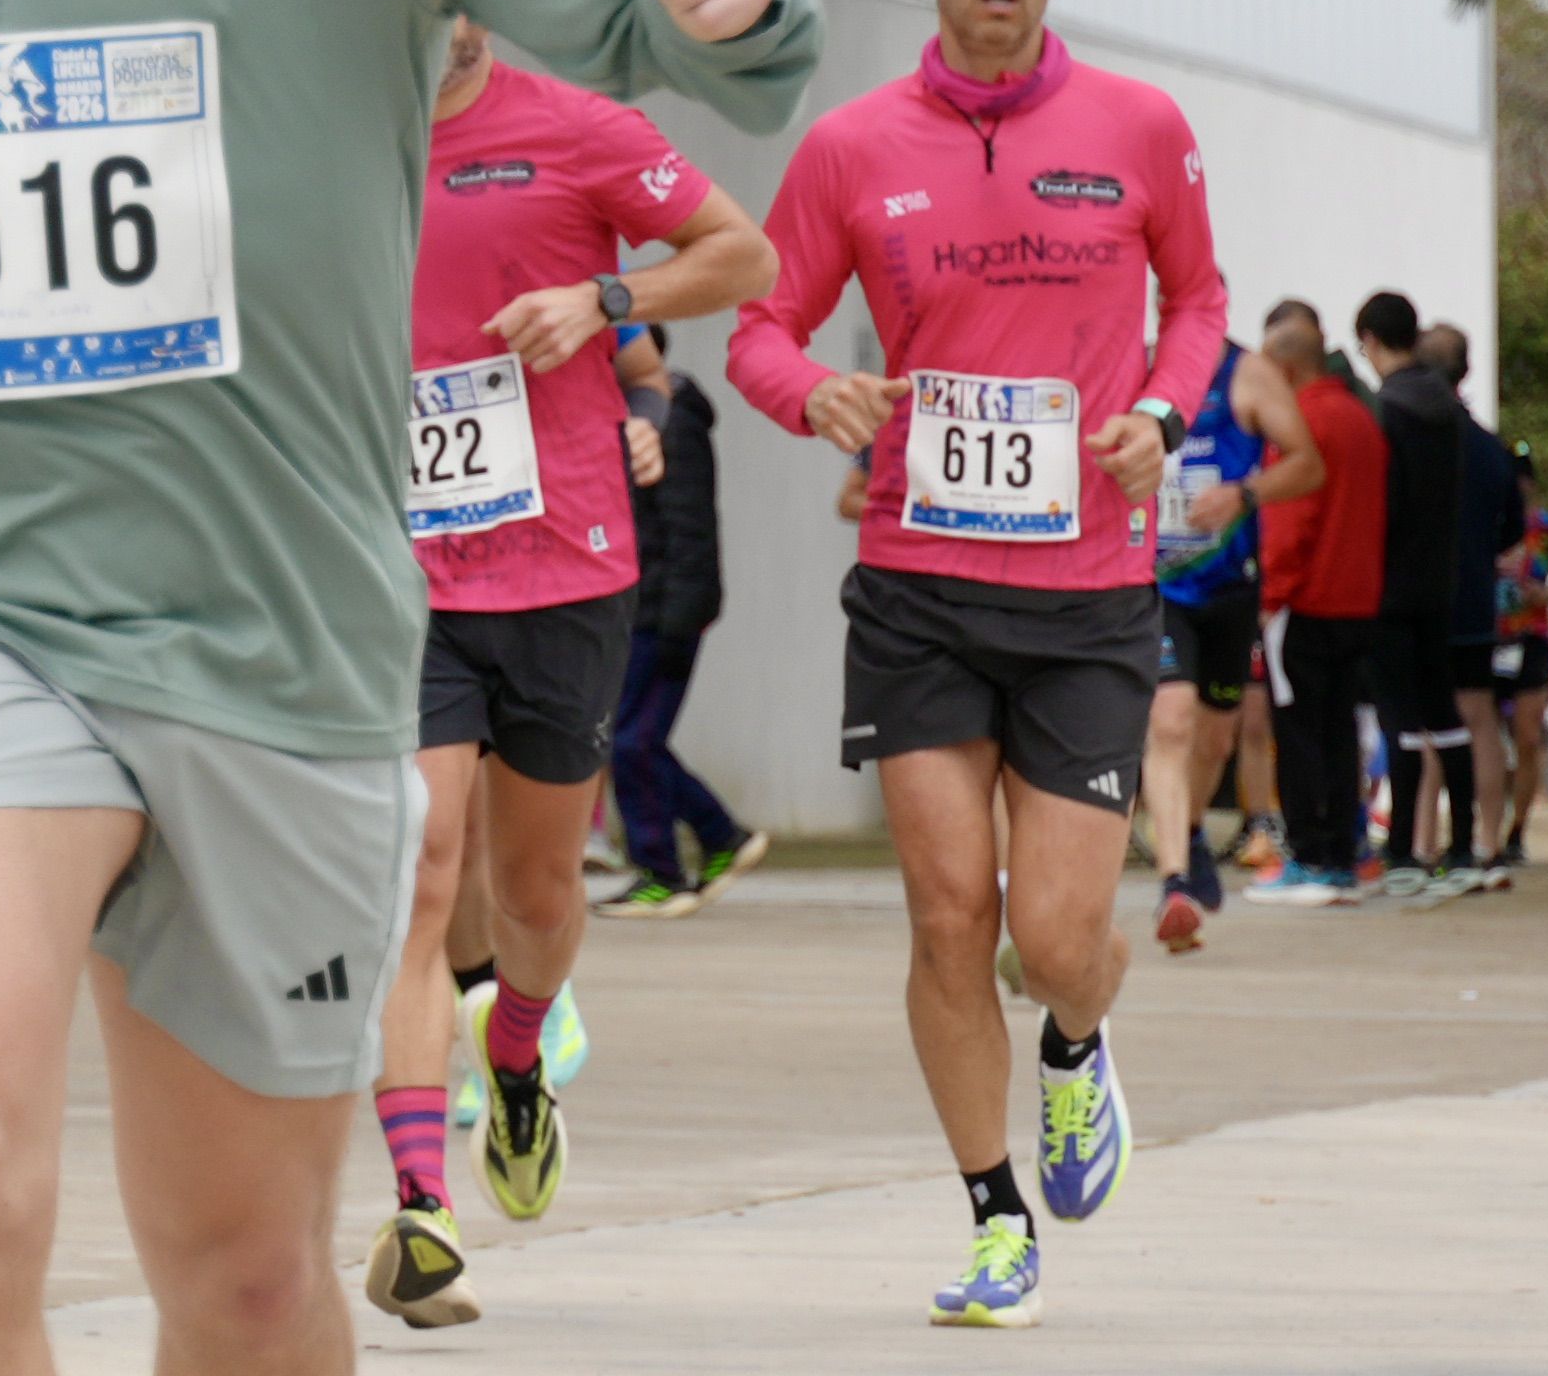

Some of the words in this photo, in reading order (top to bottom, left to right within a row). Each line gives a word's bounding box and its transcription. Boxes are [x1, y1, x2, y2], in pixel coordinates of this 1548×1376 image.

[53, 60, 100, 79] LUCENA
[112, 53, 180, 70] carreras
[113, 63, 194, 89] populares
[56, 96, 104, 122] 2026
[934, 378, 980, 420] 21K
[943, 426, 1032, 488] 613
